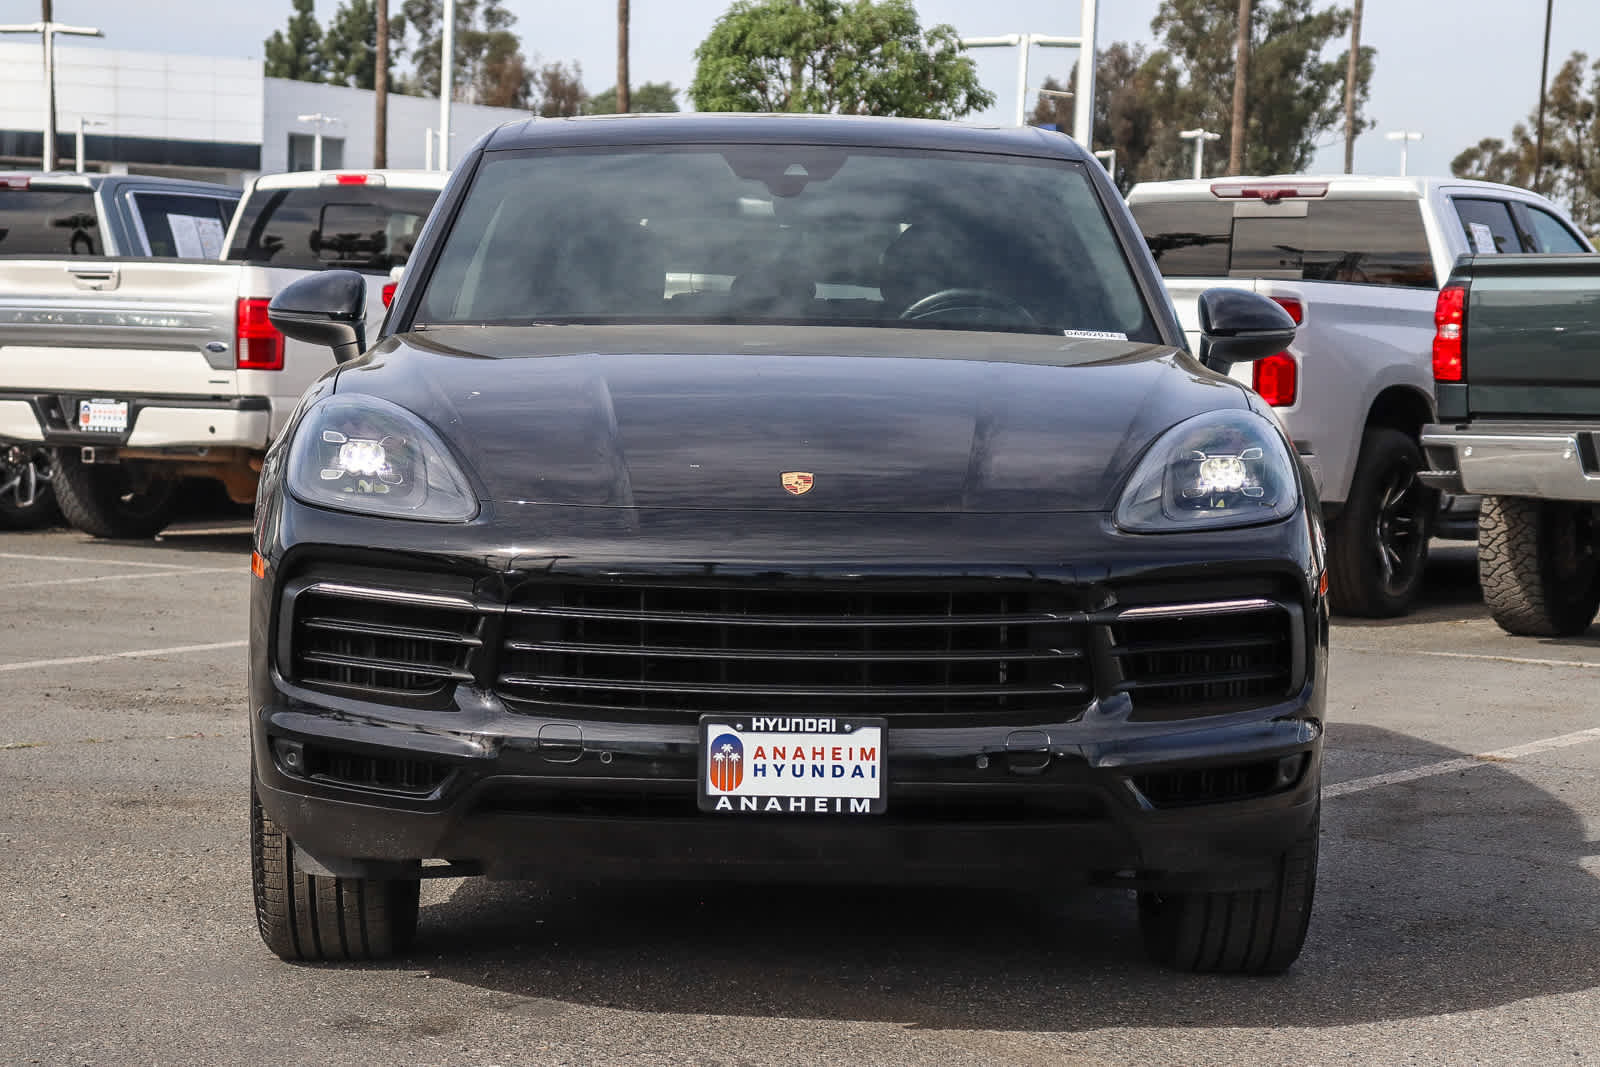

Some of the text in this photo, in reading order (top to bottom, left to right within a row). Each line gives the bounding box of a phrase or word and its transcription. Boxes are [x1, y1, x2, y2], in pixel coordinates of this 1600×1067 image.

[752, 717, 836, 733] HYUNDAI
[753, 746, 876, 761] ANAHEIM
[753, 763, 876, 778] HYUNDAI
[715, 796, 871, 813] ANAHEIM
